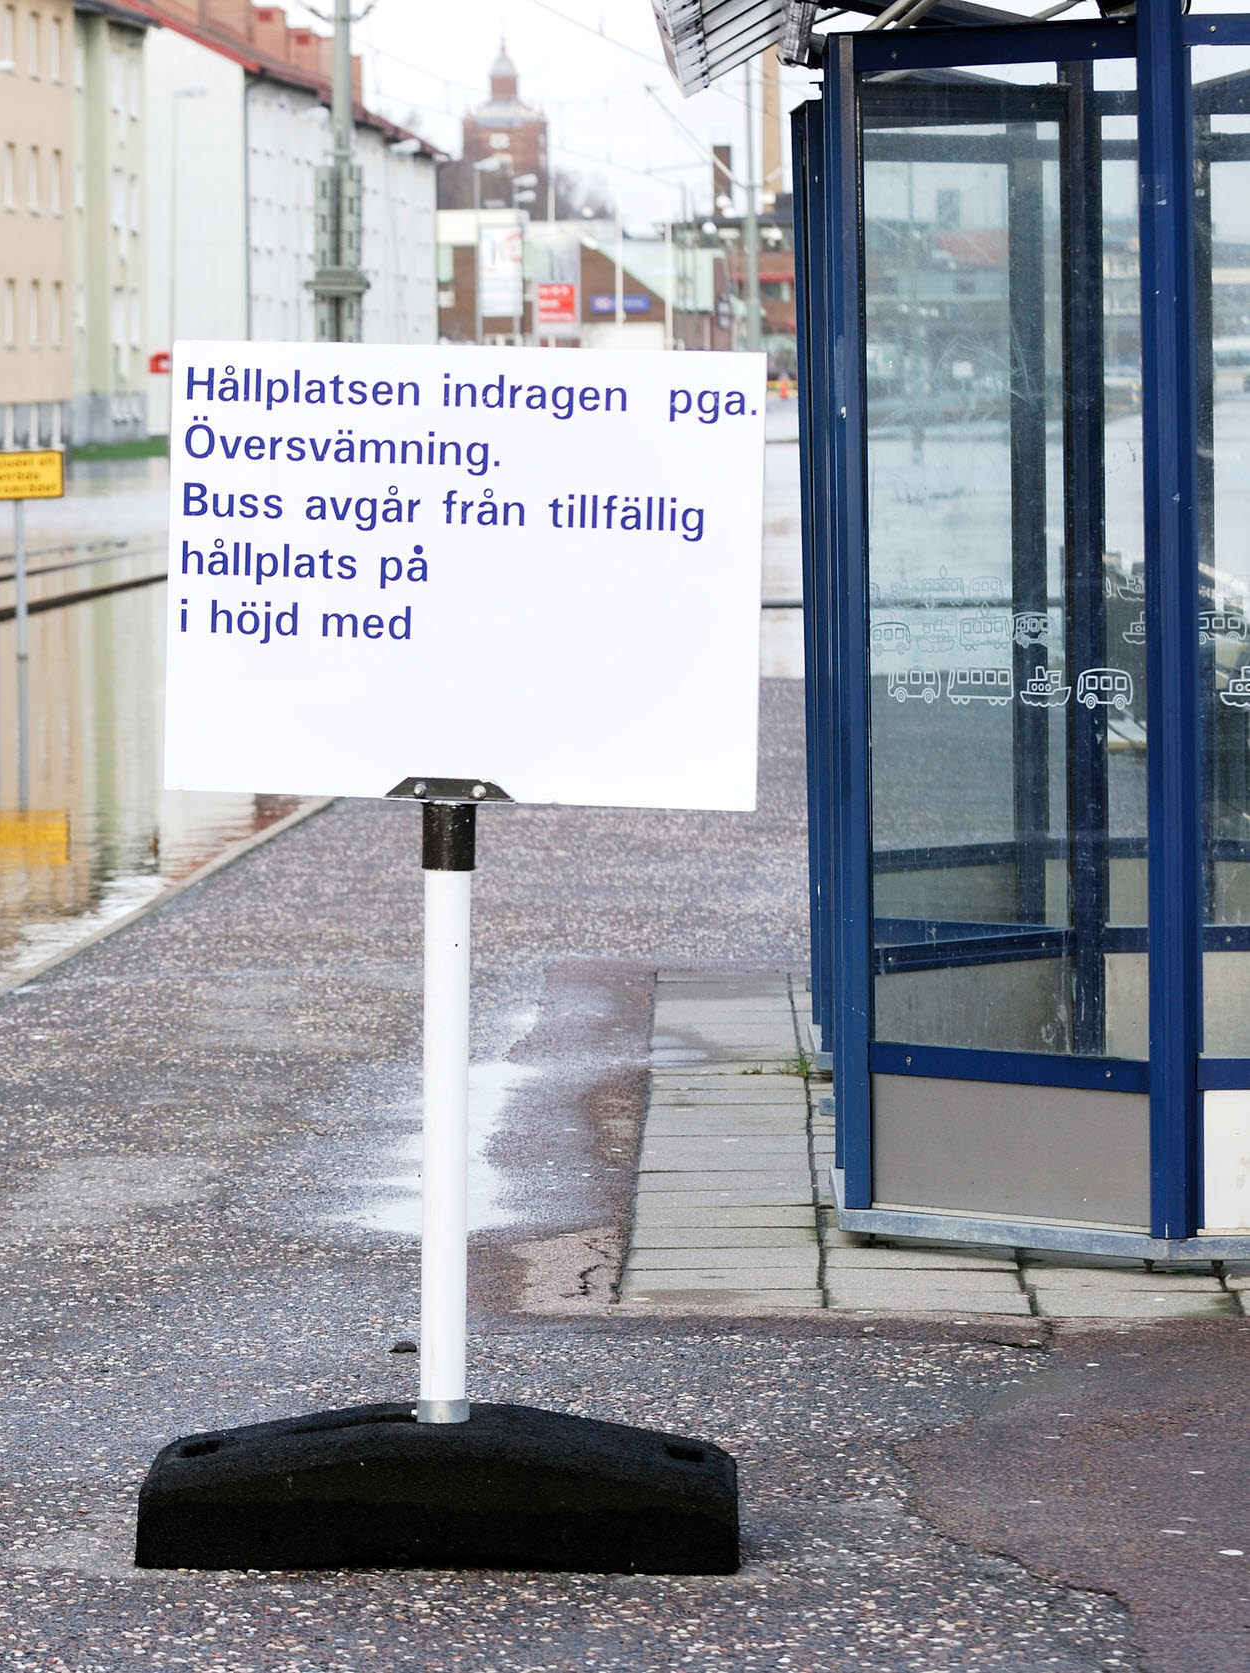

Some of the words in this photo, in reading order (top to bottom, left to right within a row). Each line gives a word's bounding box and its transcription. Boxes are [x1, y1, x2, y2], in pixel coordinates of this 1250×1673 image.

[186, 364, 420, 411] Hållplatsen
[443, 372, 627, 420] indragen
[669, 389, 758, 425] pga.
[184, 415, 501, 477] Översvämning.
[183, 482, 283, 520] Buss
[305, 485, 421, 532] avgår
[442, 488, 525, 527] från
[548, 493, 705, 542] tillfällig
[181, 538, 357, 586] hållplats
[379, 544, 428, 590] på
[180, 598, 188, 633] i
[210, 599, 299, 644] höjd
[322, 605, 412, 640] med
